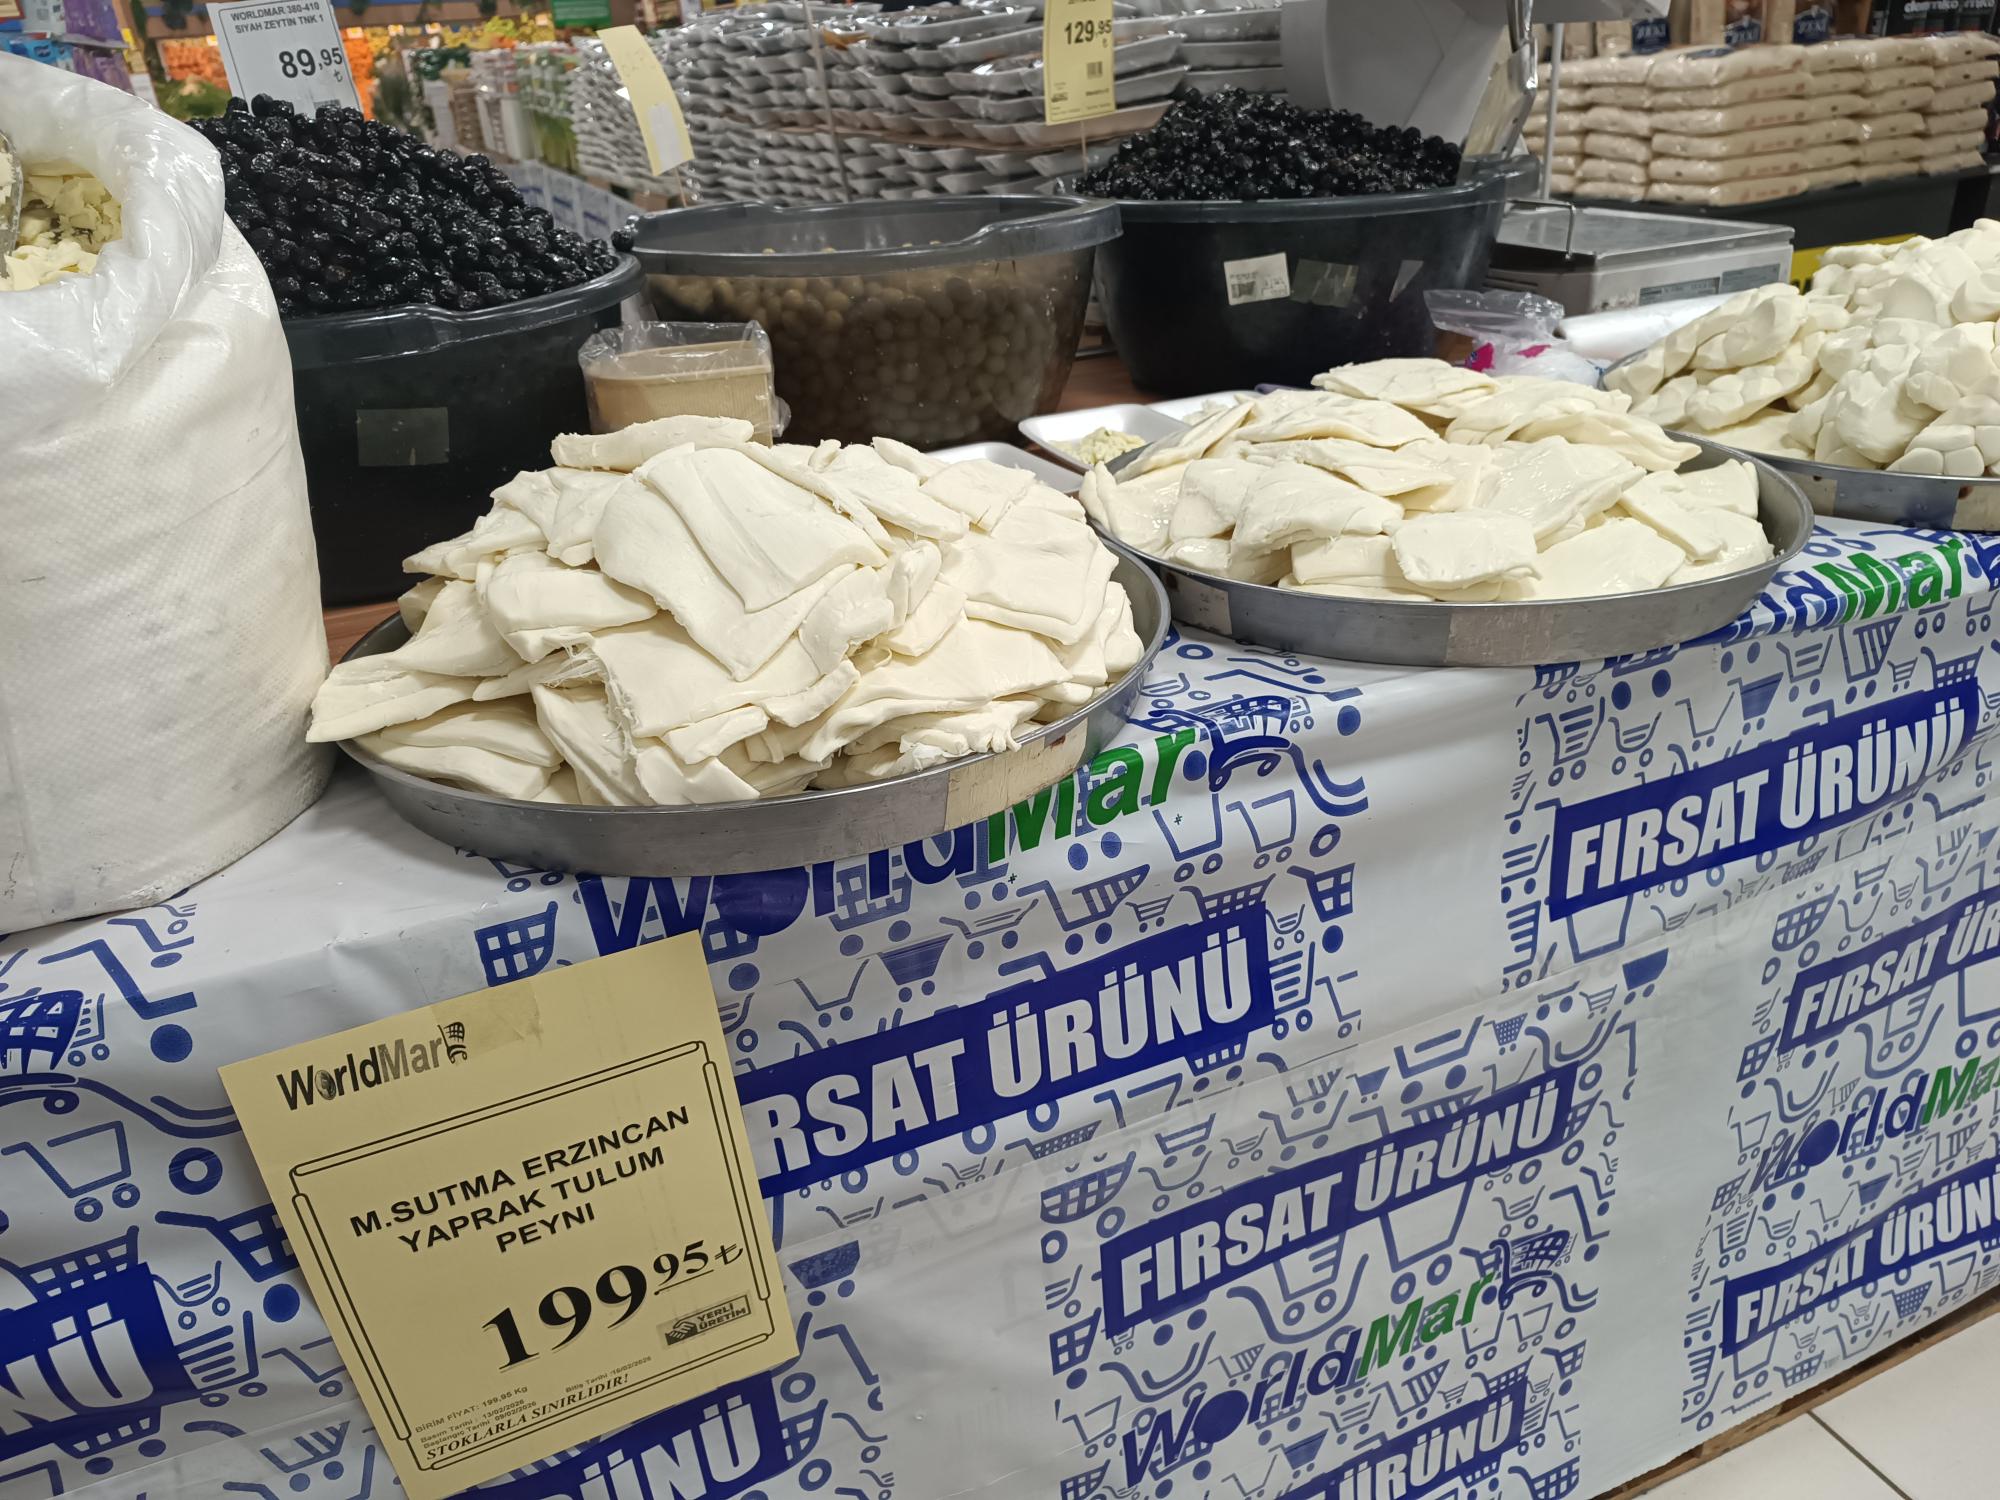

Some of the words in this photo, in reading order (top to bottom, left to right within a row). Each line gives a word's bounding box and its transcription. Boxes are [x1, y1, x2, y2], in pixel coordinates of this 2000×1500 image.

[231, 6, 286, 22] WORLDMAR
[287, 2, 320, 14] 380-410
[299, 15, 318, 26] TNK
[1565, 770, 1769, 900] FIRSAT
[1780, 697, 1966, 829] ÜRÜNÜ
[986, 925, 1253, 1099] ÜRÜNÜ
[1799, 924, 1949, 1042] FIRSAT
[350, 1169, 516, 1238] M.SUTMA
[522, 1105, 690, 1180] ERZINCAN
[398, 1188, 547, 1253] YAPRAK
[551, 1145, 665, 1201] TULUM
[496, 1202, 596, 1253] PEYNI
[1120, 1172, 1345, 1320] FIRSAT
[1353, 1078, 1561, 1211] ÜRÜNÜ
[1734, 1230, 1880, 1348] FIRSAT
[426, 1413, 528, 1461] STOKLARLA
[531, 1373, 629, 1421] SINIRLIDIR!
[1338, 1395, 1512, 1500] ÜRÜNÜ
